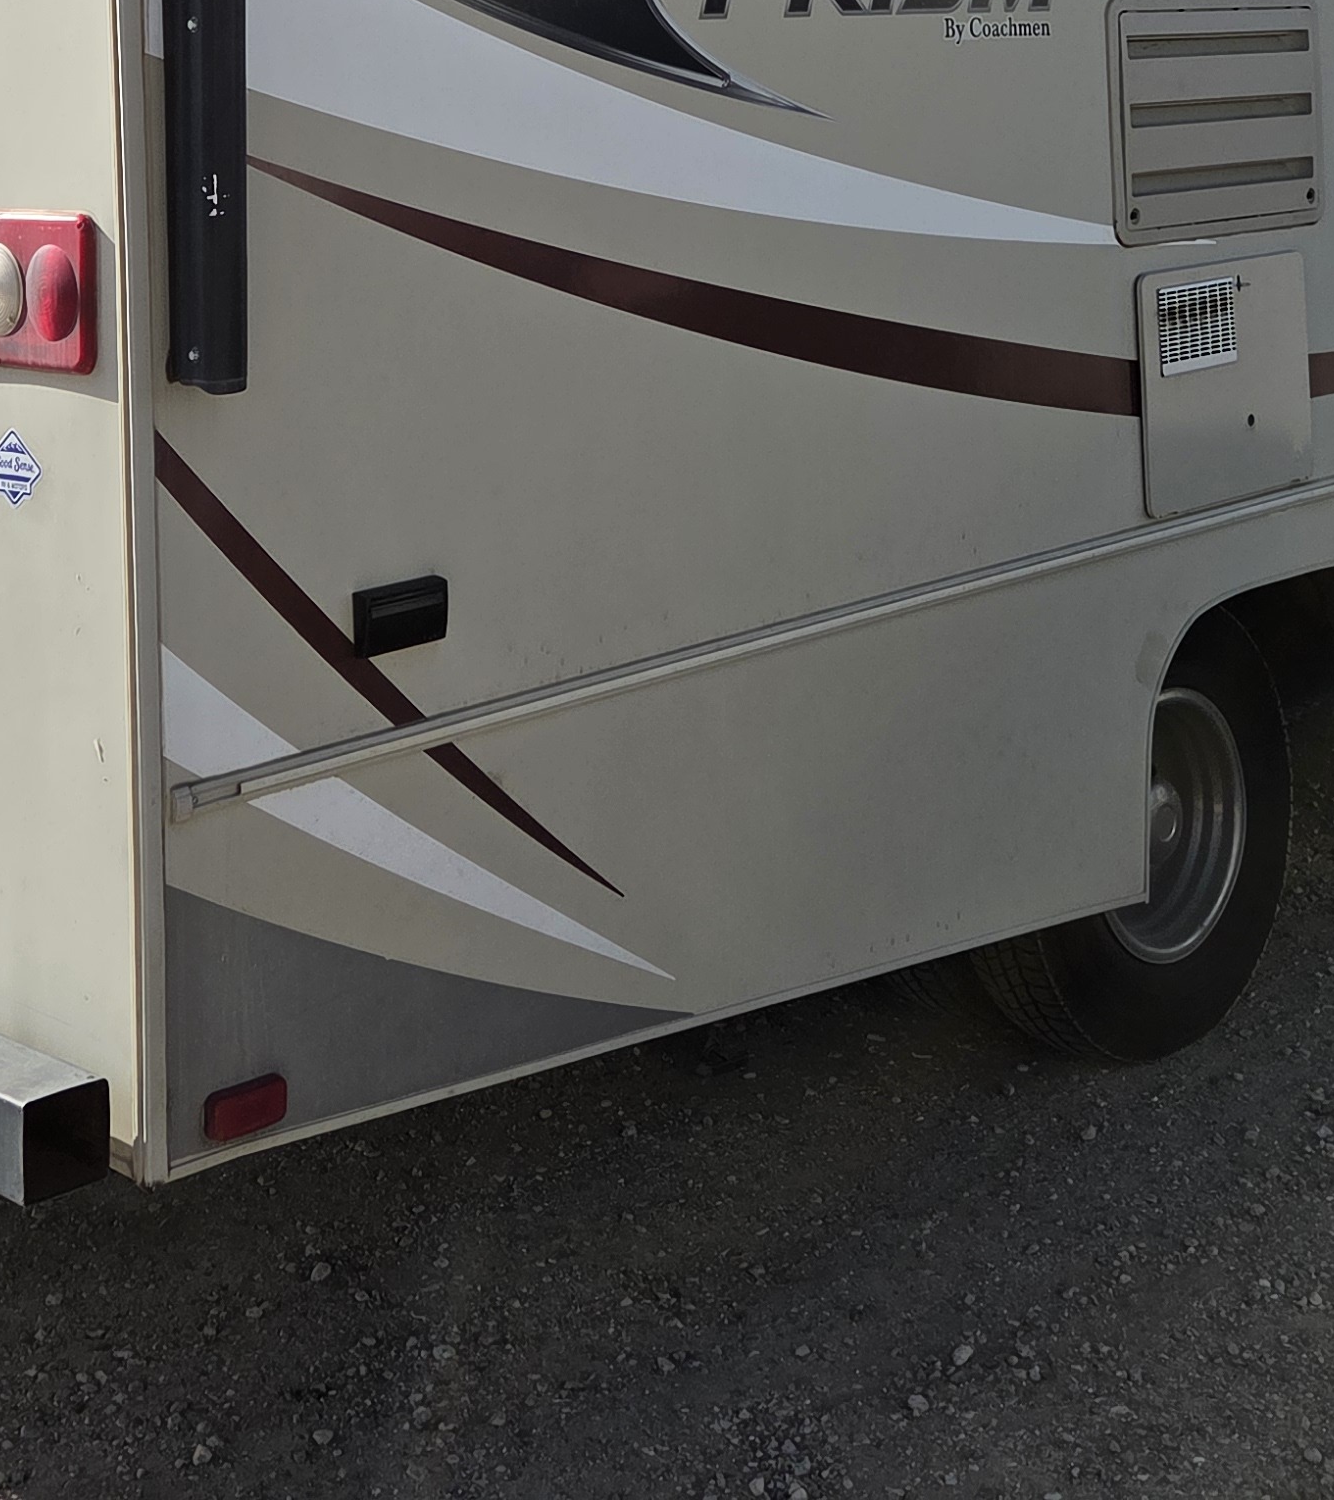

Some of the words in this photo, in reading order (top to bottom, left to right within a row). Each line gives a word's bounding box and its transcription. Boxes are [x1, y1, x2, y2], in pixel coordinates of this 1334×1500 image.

[944, 17, 965, 45] By
[969, 16, 1051, 38] Coachmen
[14, 456, 35, 474] Sense
